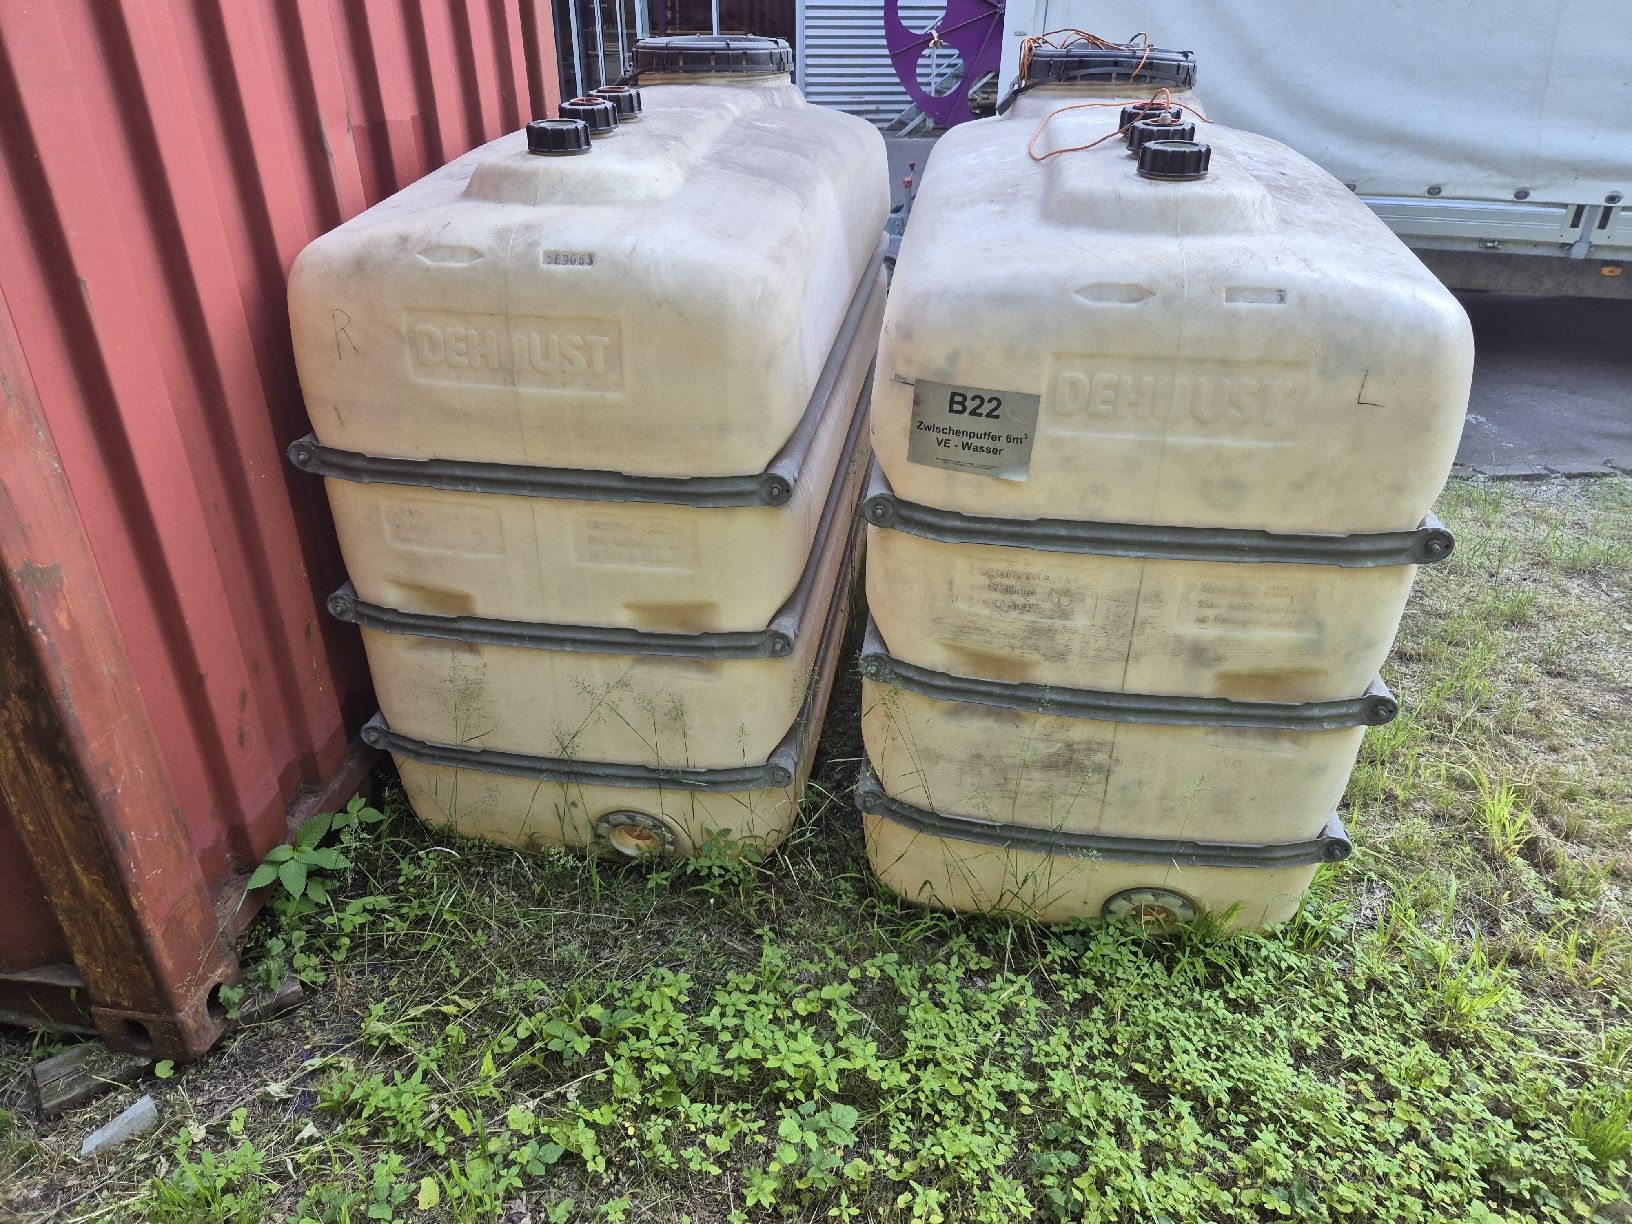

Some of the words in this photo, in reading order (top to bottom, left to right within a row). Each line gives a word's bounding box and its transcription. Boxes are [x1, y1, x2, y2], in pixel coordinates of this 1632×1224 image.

[331, 308, 359, 361] R
[947, 391, 1003, 420] B22
[916, 420, 1003, 443] Zwischenpuffer
[935, 437, 952, 449] VE
[961, 440, 1005, 456] Wasser
